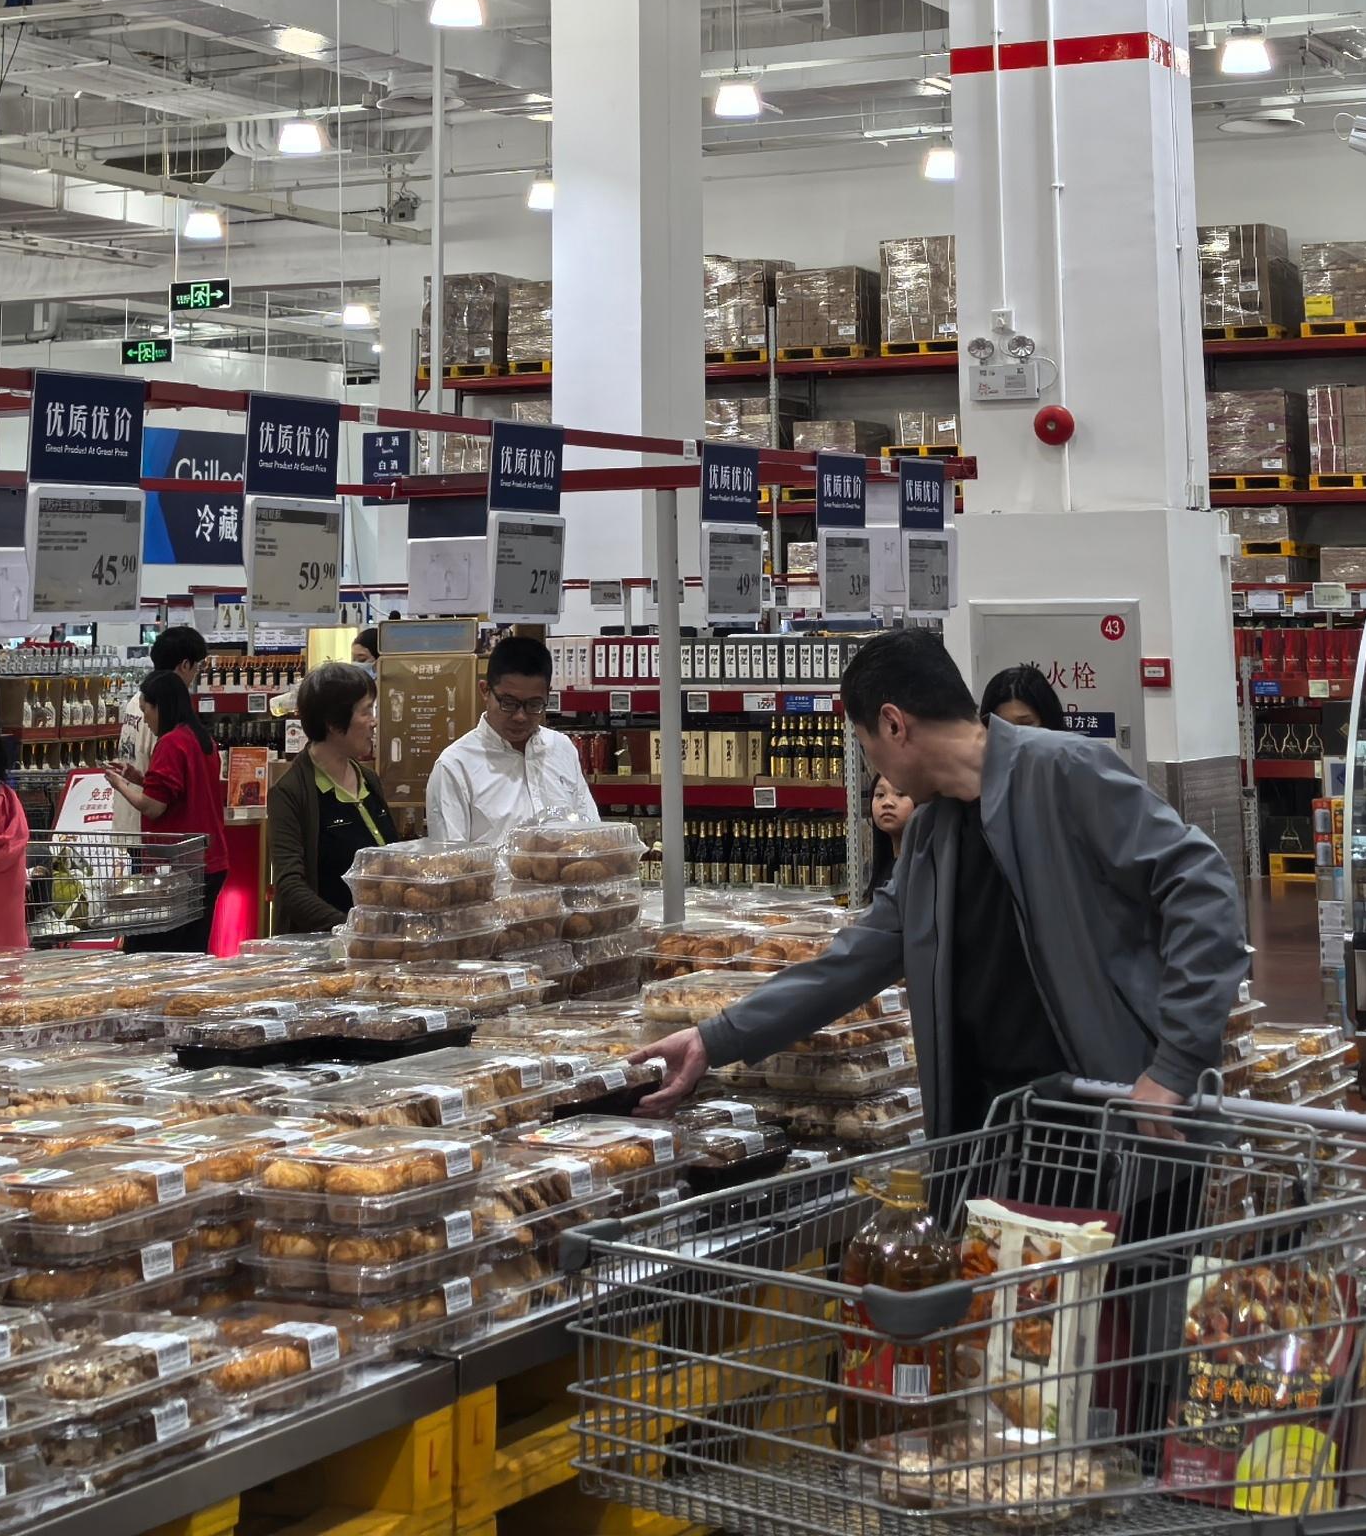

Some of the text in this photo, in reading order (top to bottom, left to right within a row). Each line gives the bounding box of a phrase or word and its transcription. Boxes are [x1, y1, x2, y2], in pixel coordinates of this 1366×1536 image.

[46, 401, 132, 443] 优质优价
[259, 421, 330, 459] 优质优价
[500, 445, 555, 479] 优质优价
[709, 464, 752, 492] 优质优价
[823, 474, 862, 500] 优质优价
[905, 479, 939, 503] 优质优价
[195, 503, 239, 543] 冷藏
[92, 554, 136, 586] 45.90
[298, 562, 335, 591] 59.90
[1105, 620, 1120, 636] 43
[1019, 661, 1097, 690] 火栓
